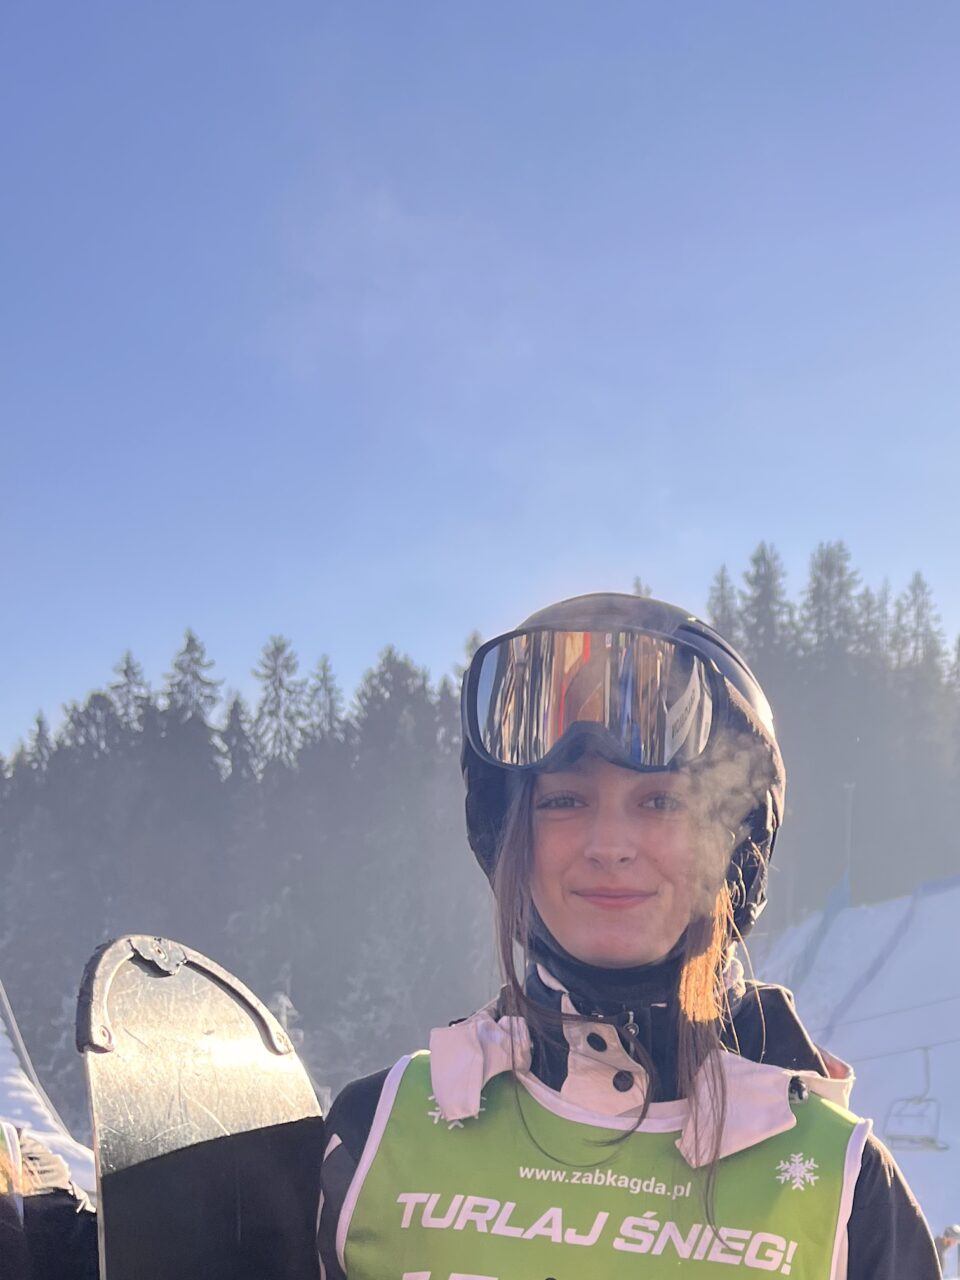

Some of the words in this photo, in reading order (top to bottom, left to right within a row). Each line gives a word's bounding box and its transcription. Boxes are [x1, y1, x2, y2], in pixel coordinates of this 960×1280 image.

[519, 1166, 692, 1200] www.zabkagda.pl
[396, 1192, 609, 1247] TURLAJ
[613, 1211, 798, 1275] ŚNIEG!
